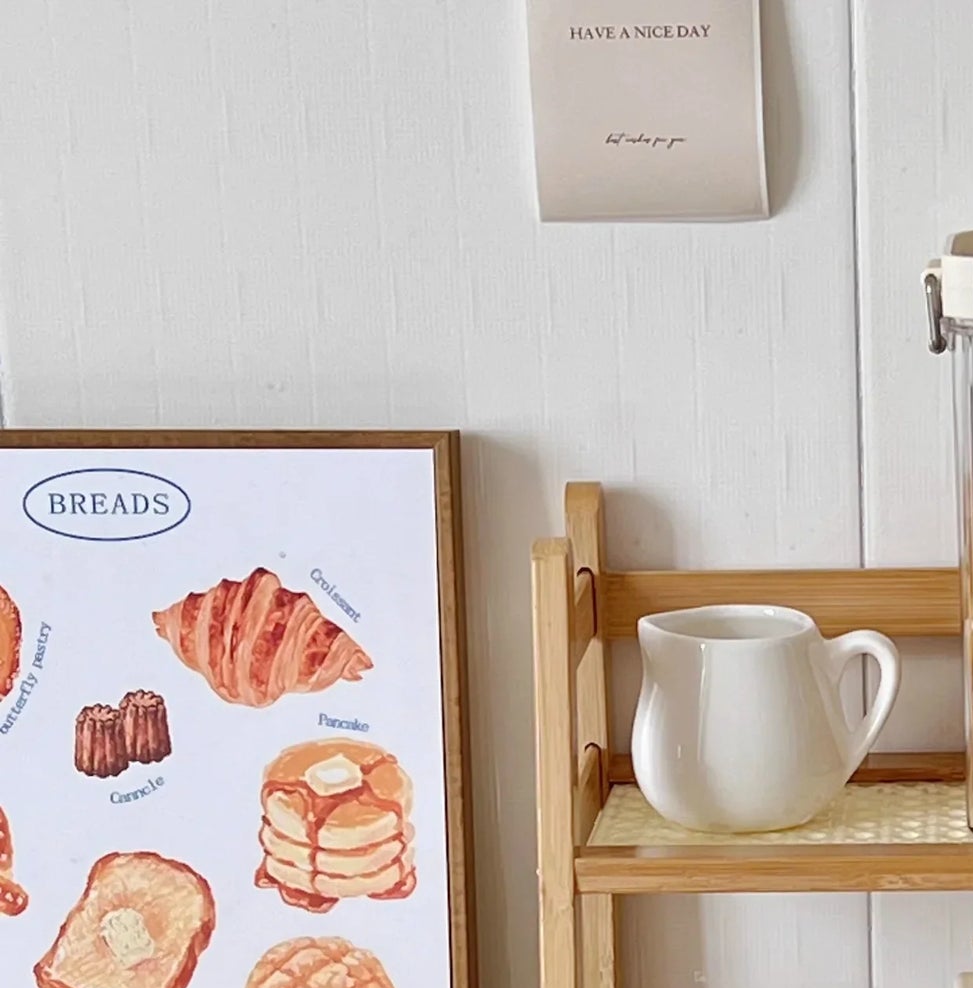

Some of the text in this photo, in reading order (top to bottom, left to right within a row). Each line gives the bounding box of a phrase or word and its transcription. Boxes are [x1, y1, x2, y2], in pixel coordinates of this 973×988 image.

[569, 24, 711, 40] HAVE A NICE DAY
[47, 492, 171, 516] BREADS
[310, 568, 362, 623] Croissant
[32, 621, 52, 669] pastry
[318, 713, 370, 733] Pancake
